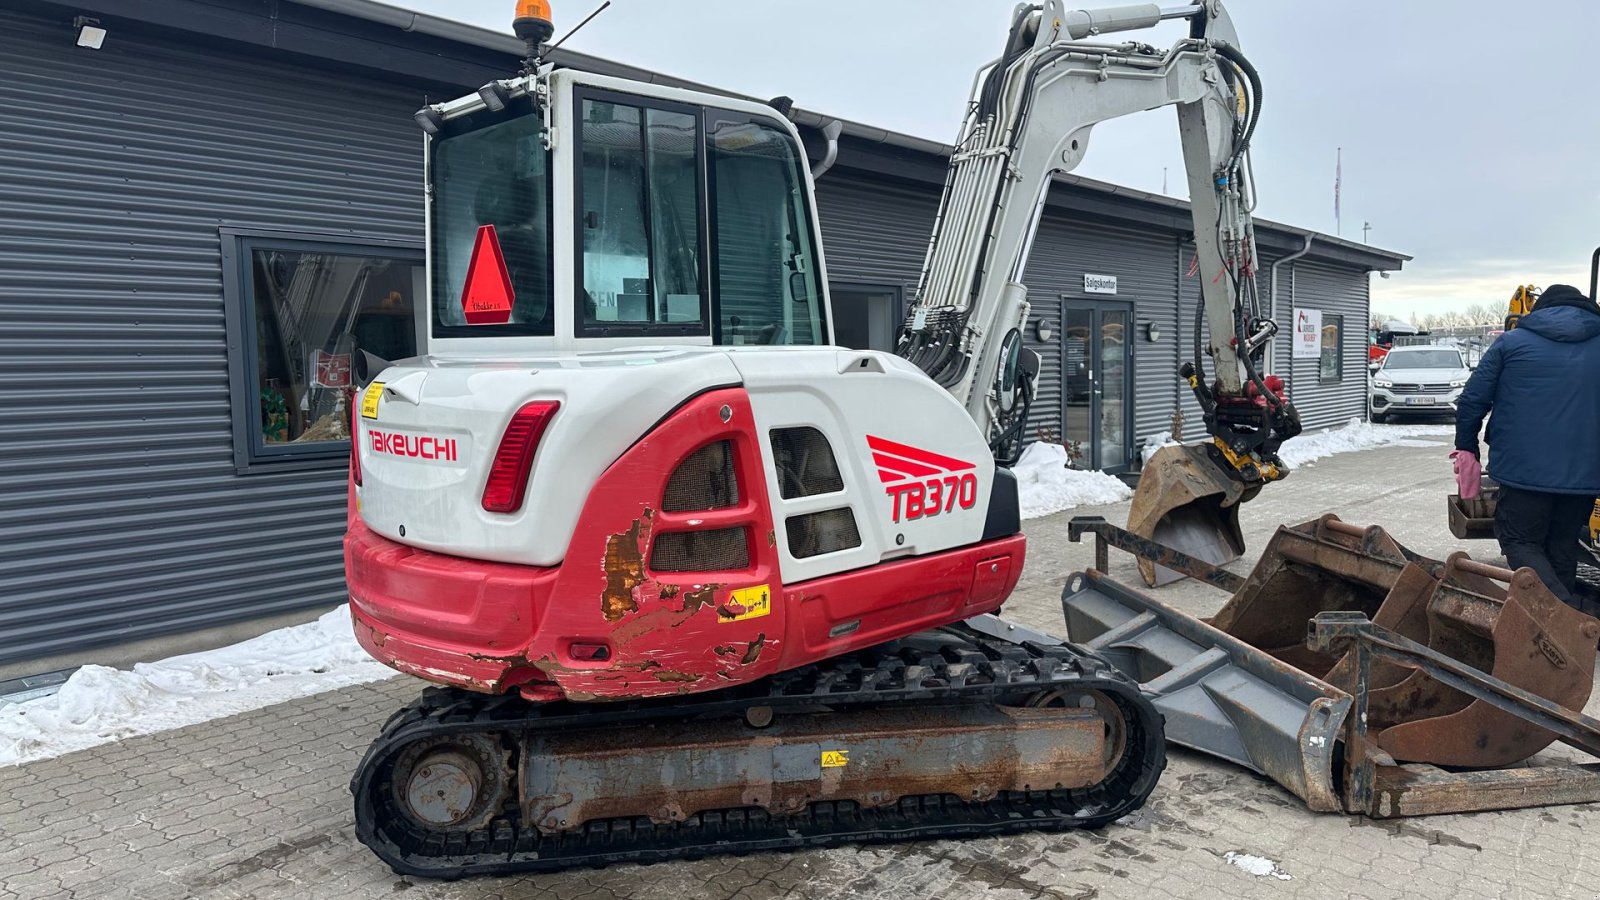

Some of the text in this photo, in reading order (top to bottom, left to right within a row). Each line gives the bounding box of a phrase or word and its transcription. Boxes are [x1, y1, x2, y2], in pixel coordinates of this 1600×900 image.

[1085, 277, 1116, 291] Salgskontor
[369, 430, 457, 461] TAKEUCHI
[885, 472, 977, 523] TB370
